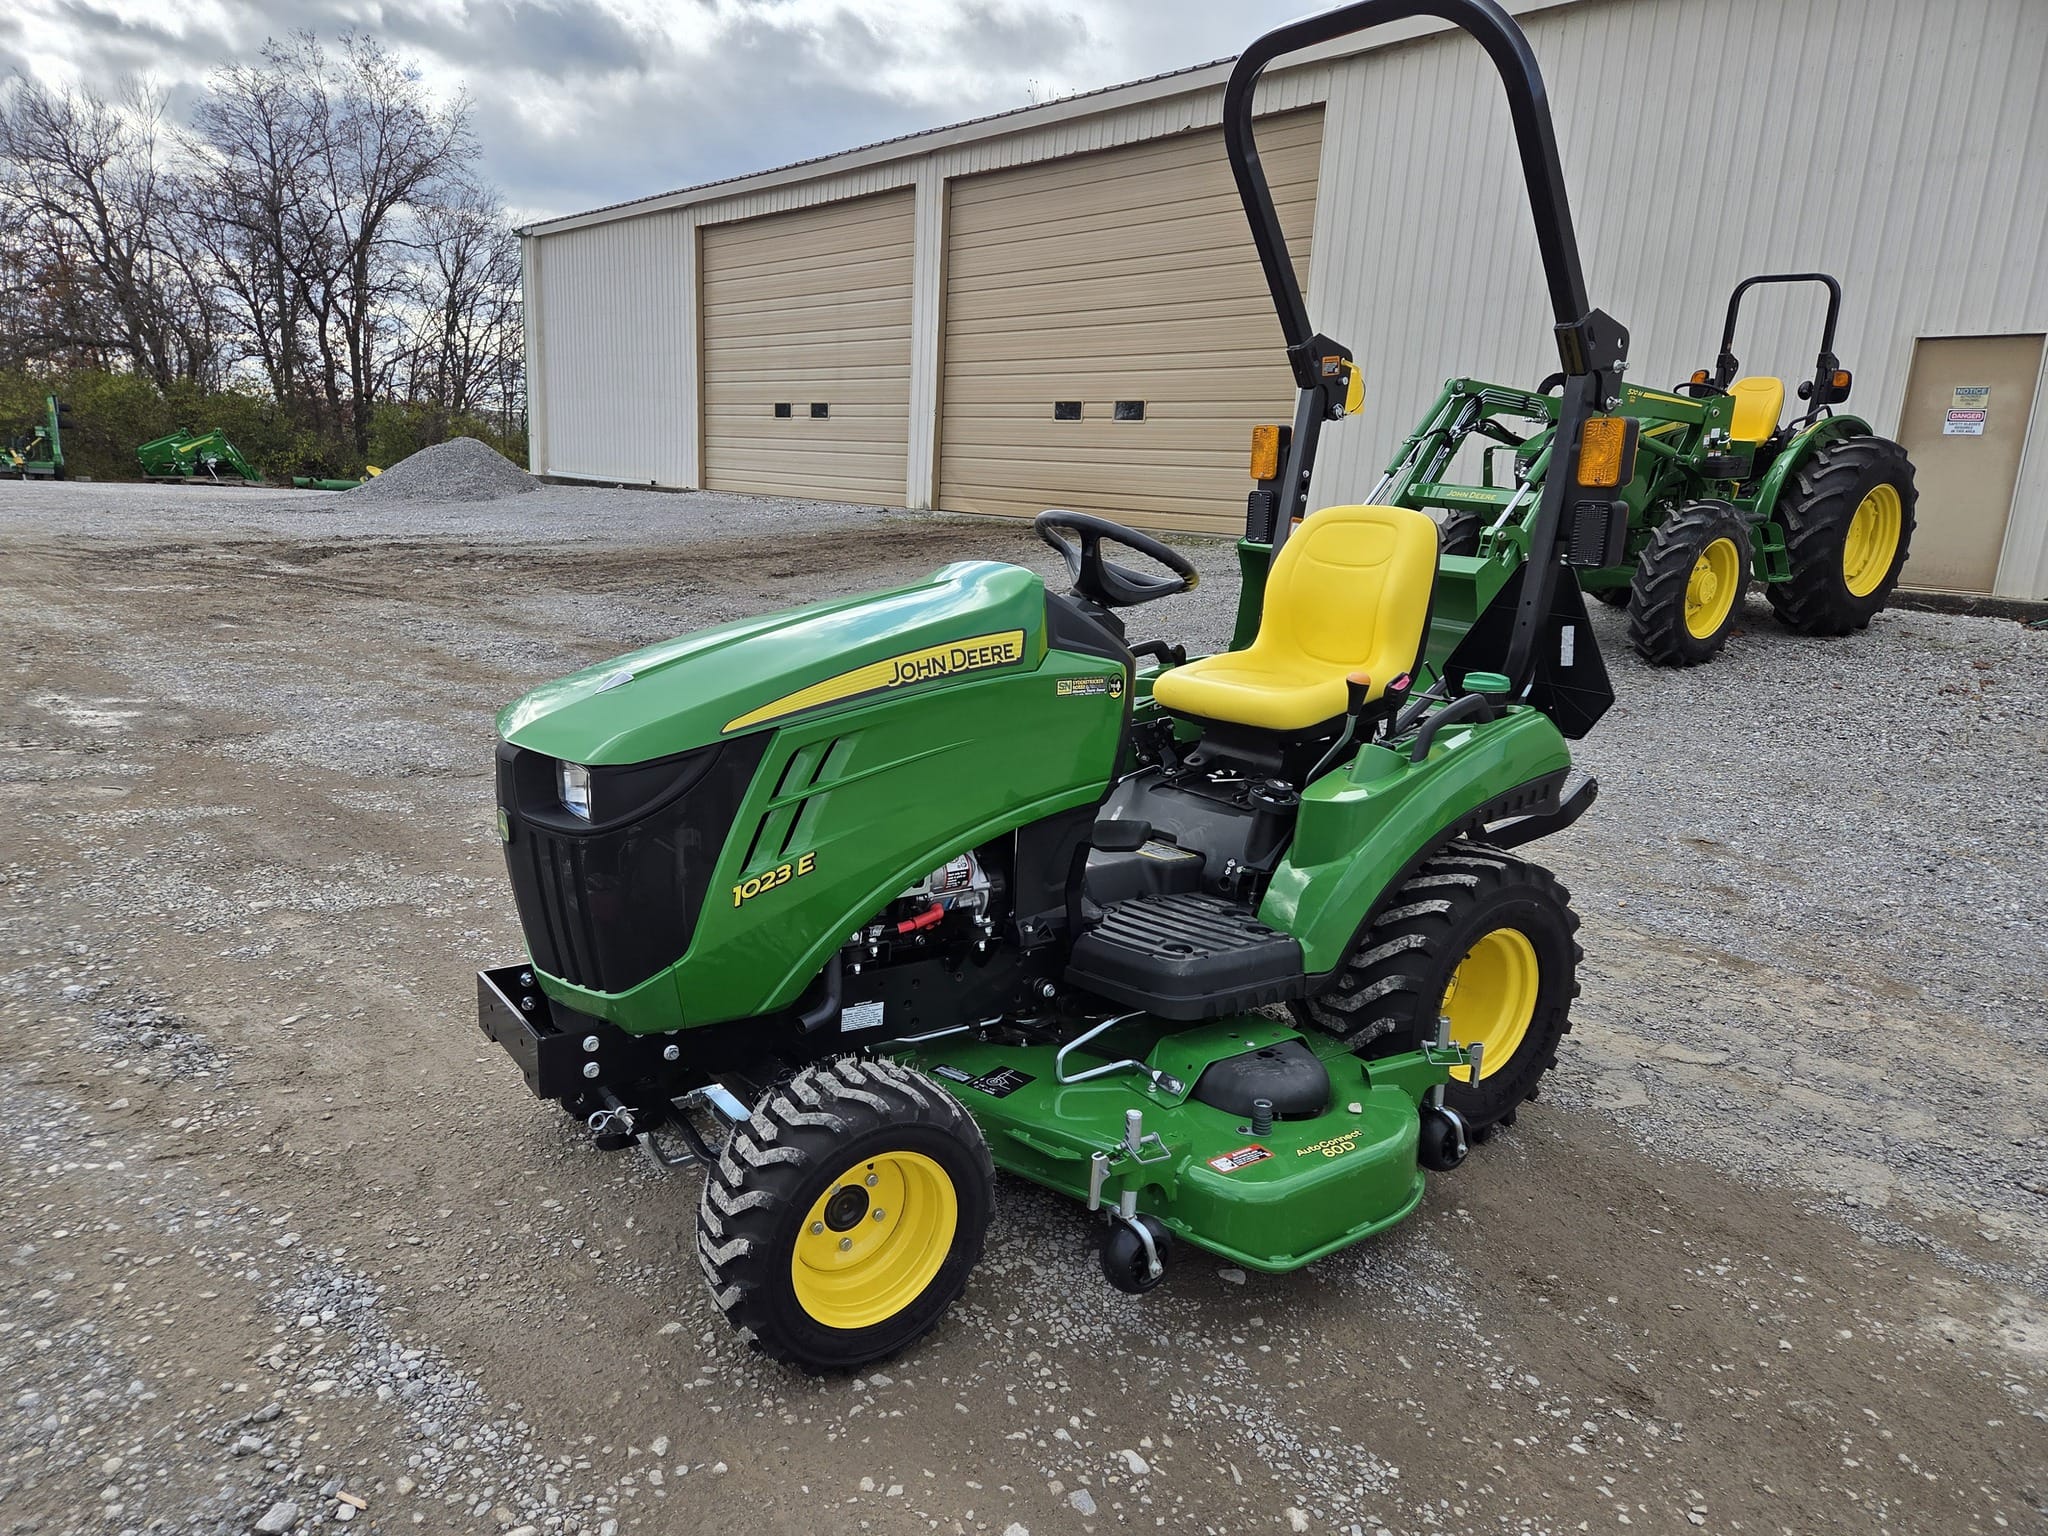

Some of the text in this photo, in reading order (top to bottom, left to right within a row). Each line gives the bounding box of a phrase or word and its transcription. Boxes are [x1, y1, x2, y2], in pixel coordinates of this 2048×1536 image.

[1447, 489, 1497, 501] JOHN DEERE
[888, 643, 1015, 685] JOHN DEERE
[732, 851, 816, 908] 1023 E
[1296, 1129, 1363, 1157] AutoConnect
[1321, 1141, 1356, 1158] 60D
